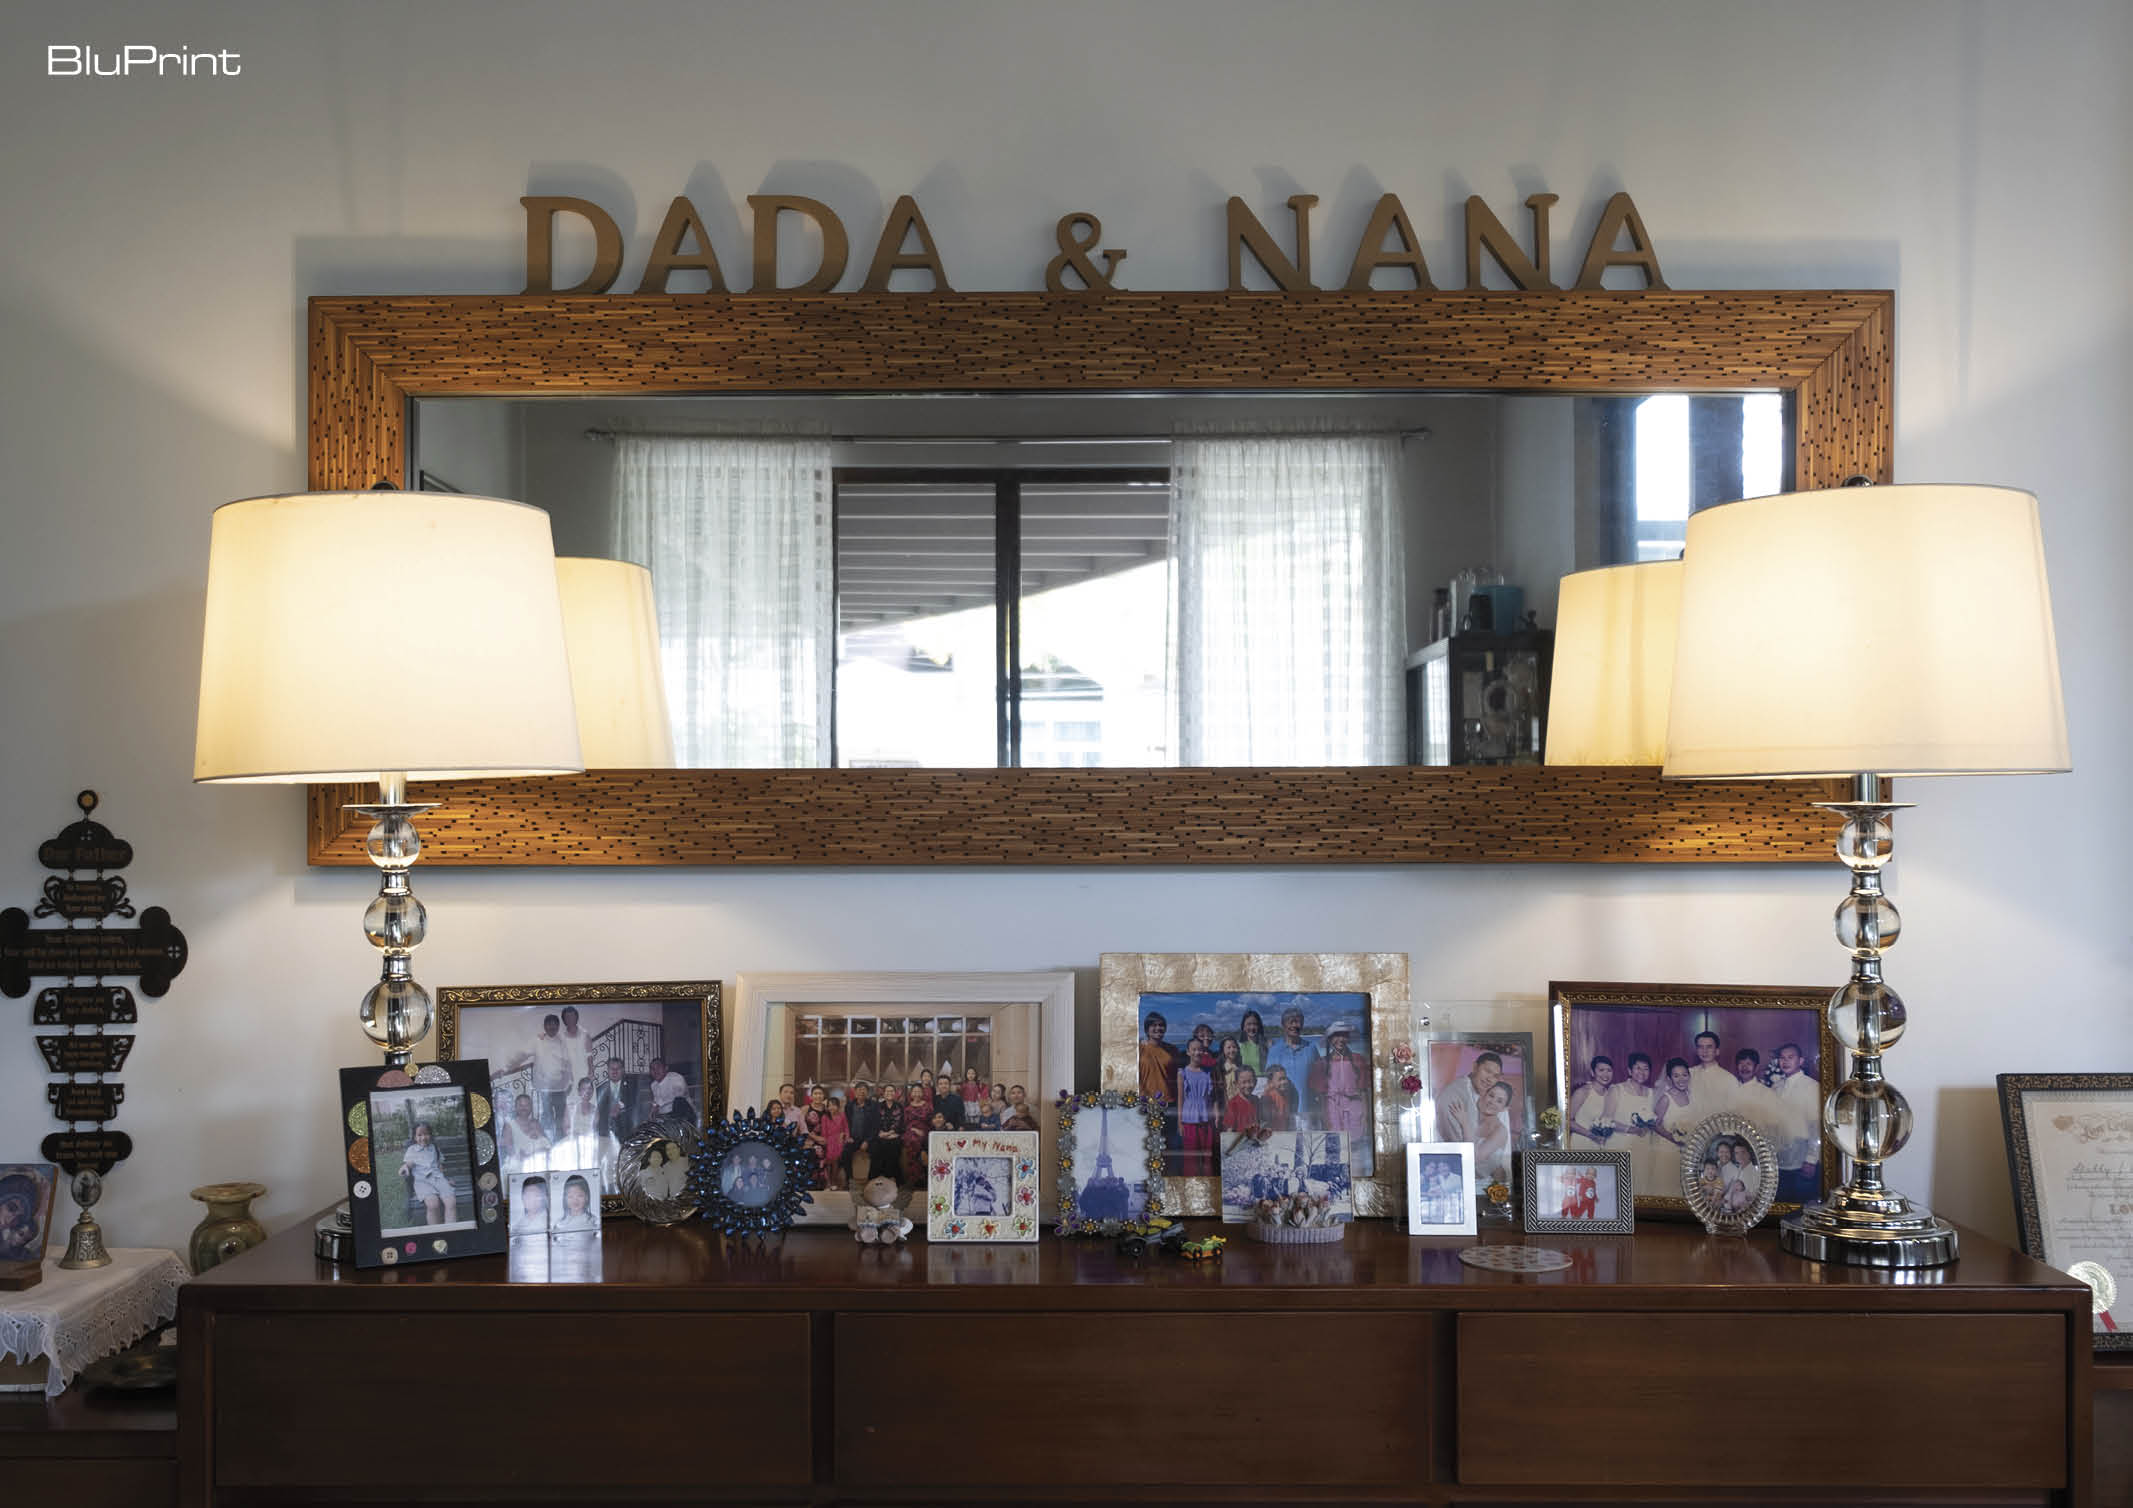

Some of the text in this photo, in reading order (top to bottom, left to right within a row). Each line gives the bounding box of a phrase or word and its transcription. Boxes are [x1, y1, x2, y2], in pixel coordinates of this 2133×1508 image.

[519, 191, 1671, 296] DADA & NANA
